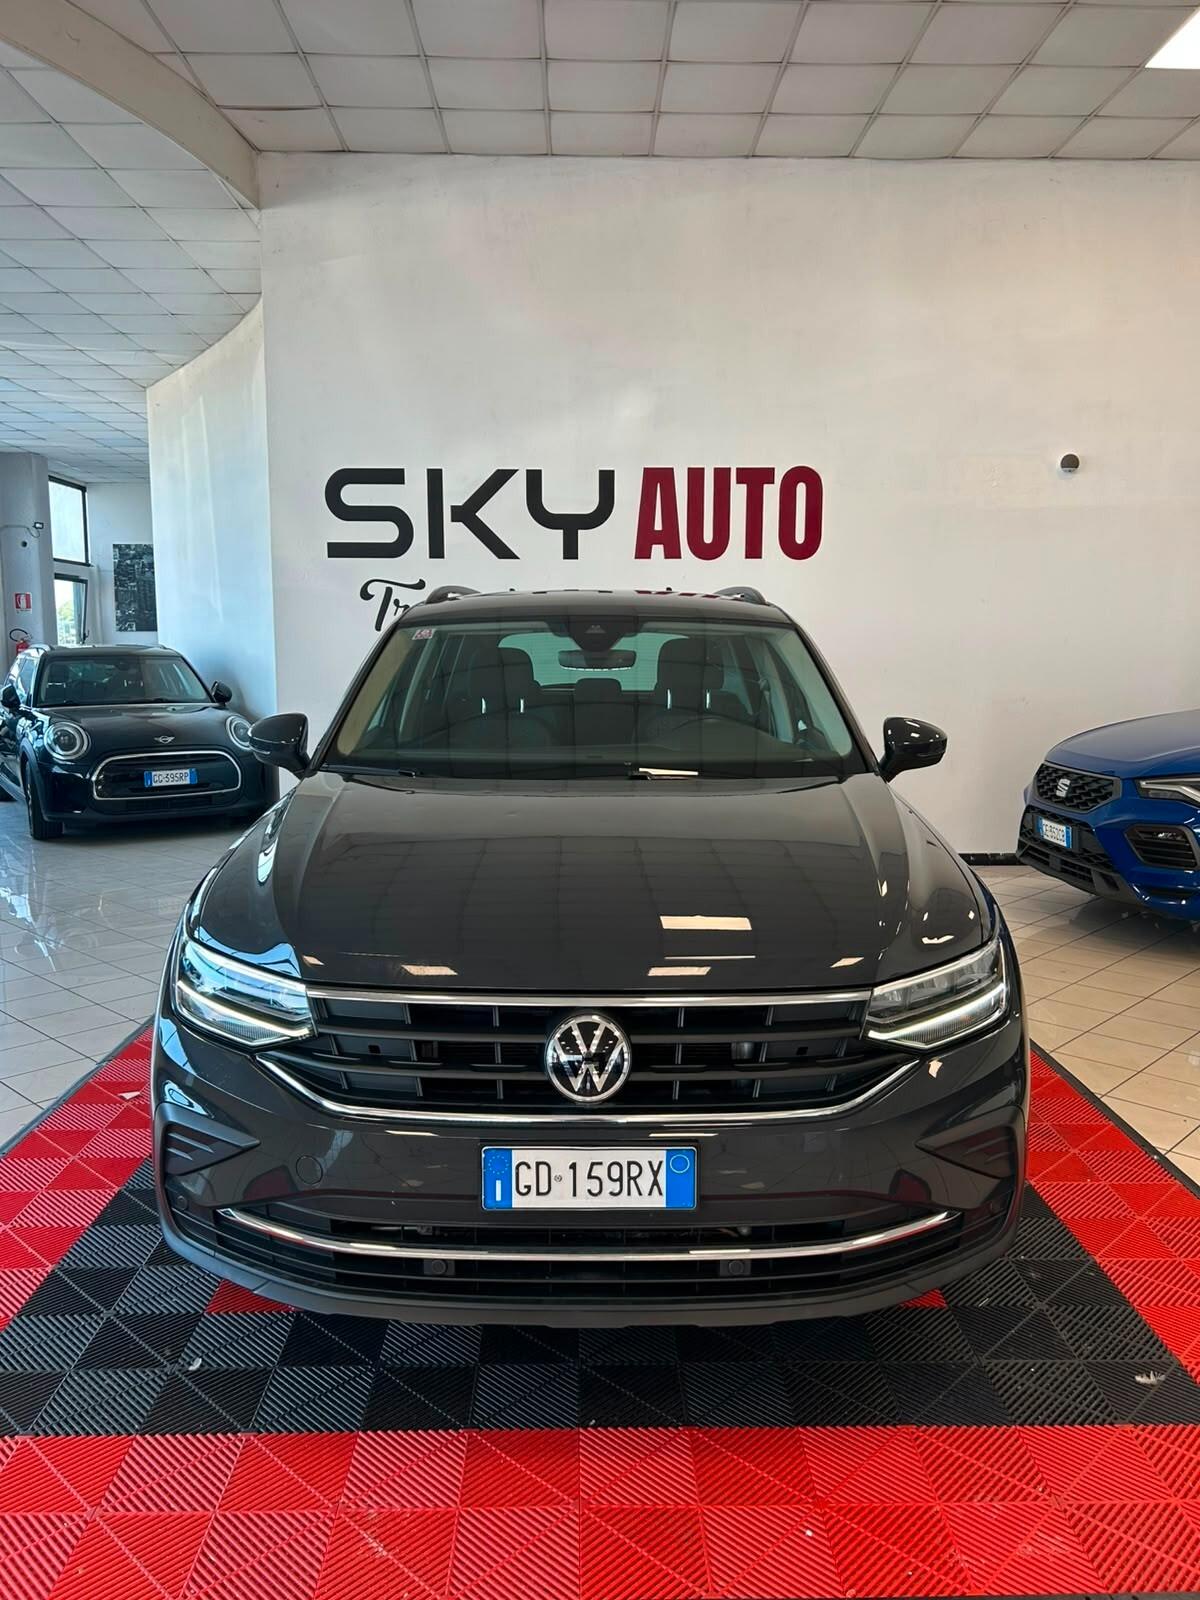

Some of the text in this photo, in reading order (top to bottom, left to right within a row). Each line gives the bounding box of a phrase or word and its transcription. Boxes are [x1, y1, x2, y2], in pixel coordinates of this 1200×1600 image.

[324, 465, 824, 561] SKY AUTO
[359, 578, 426, 632] Tr
[514, 1160, 552, 1197] GD
[568, 1159, 664, 1198] 159RX
